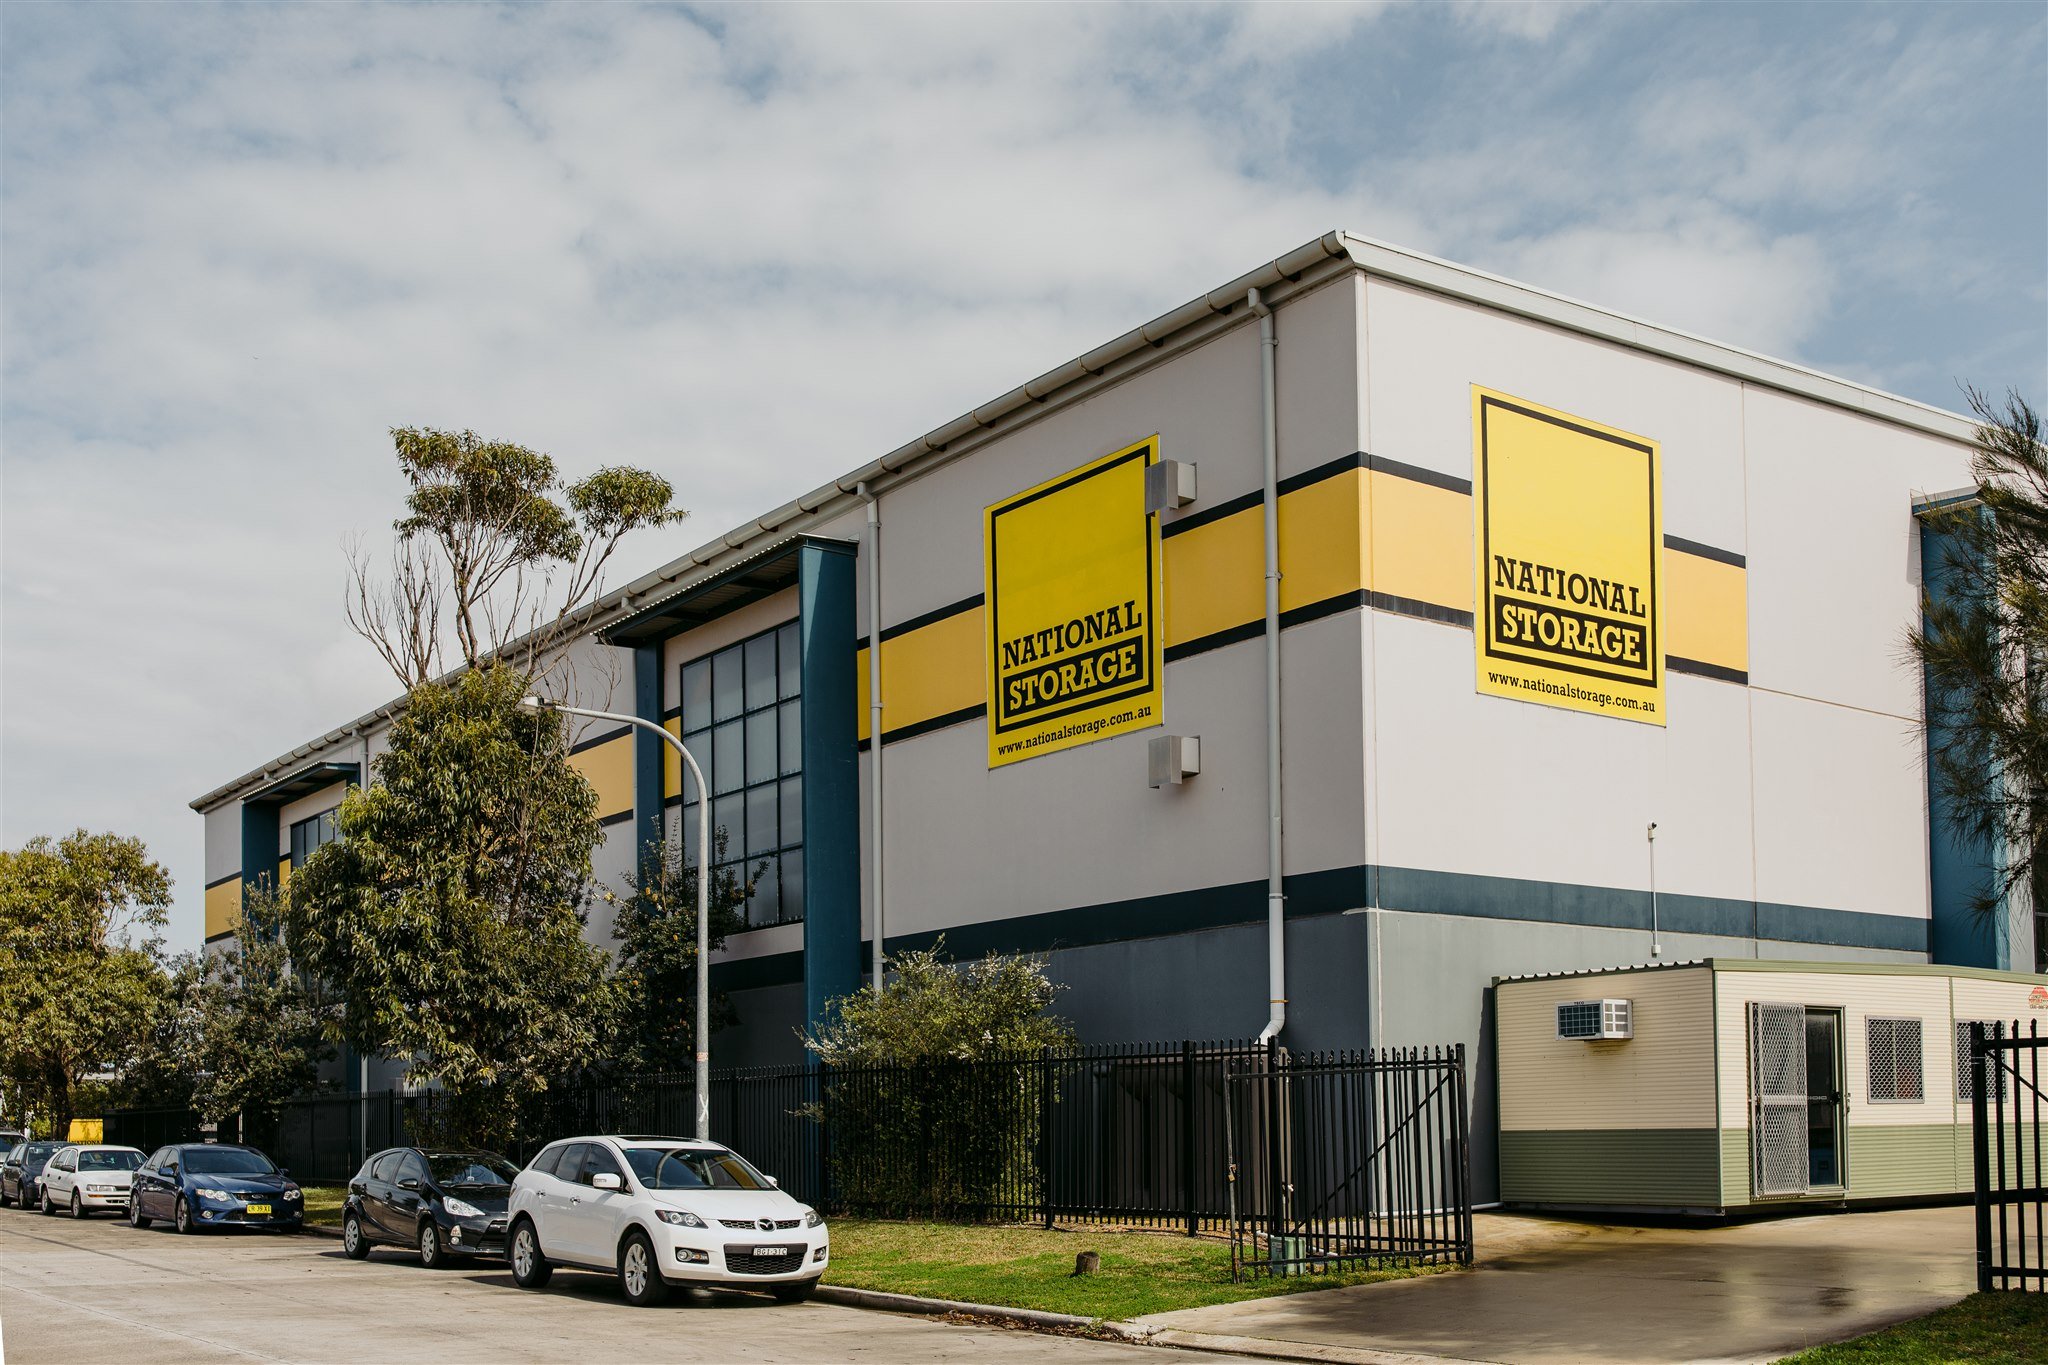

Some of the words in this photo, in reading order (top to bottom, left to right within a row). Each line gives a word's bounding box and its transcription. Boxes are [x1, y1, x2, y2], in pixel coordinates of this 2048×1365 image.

[1494, 555, 1646, 618] NATIONAL
[1003, 600, 1142, 670] NATIONAL
[1502, 604, 1640, 663] STORAGE
[1009, 645, 1136, 710] STORAGE
[1488, 672, 1656, 713] www.nationalstorage.com.au
[998, 706, 1152, 756] www.nationalstorage.com.au
